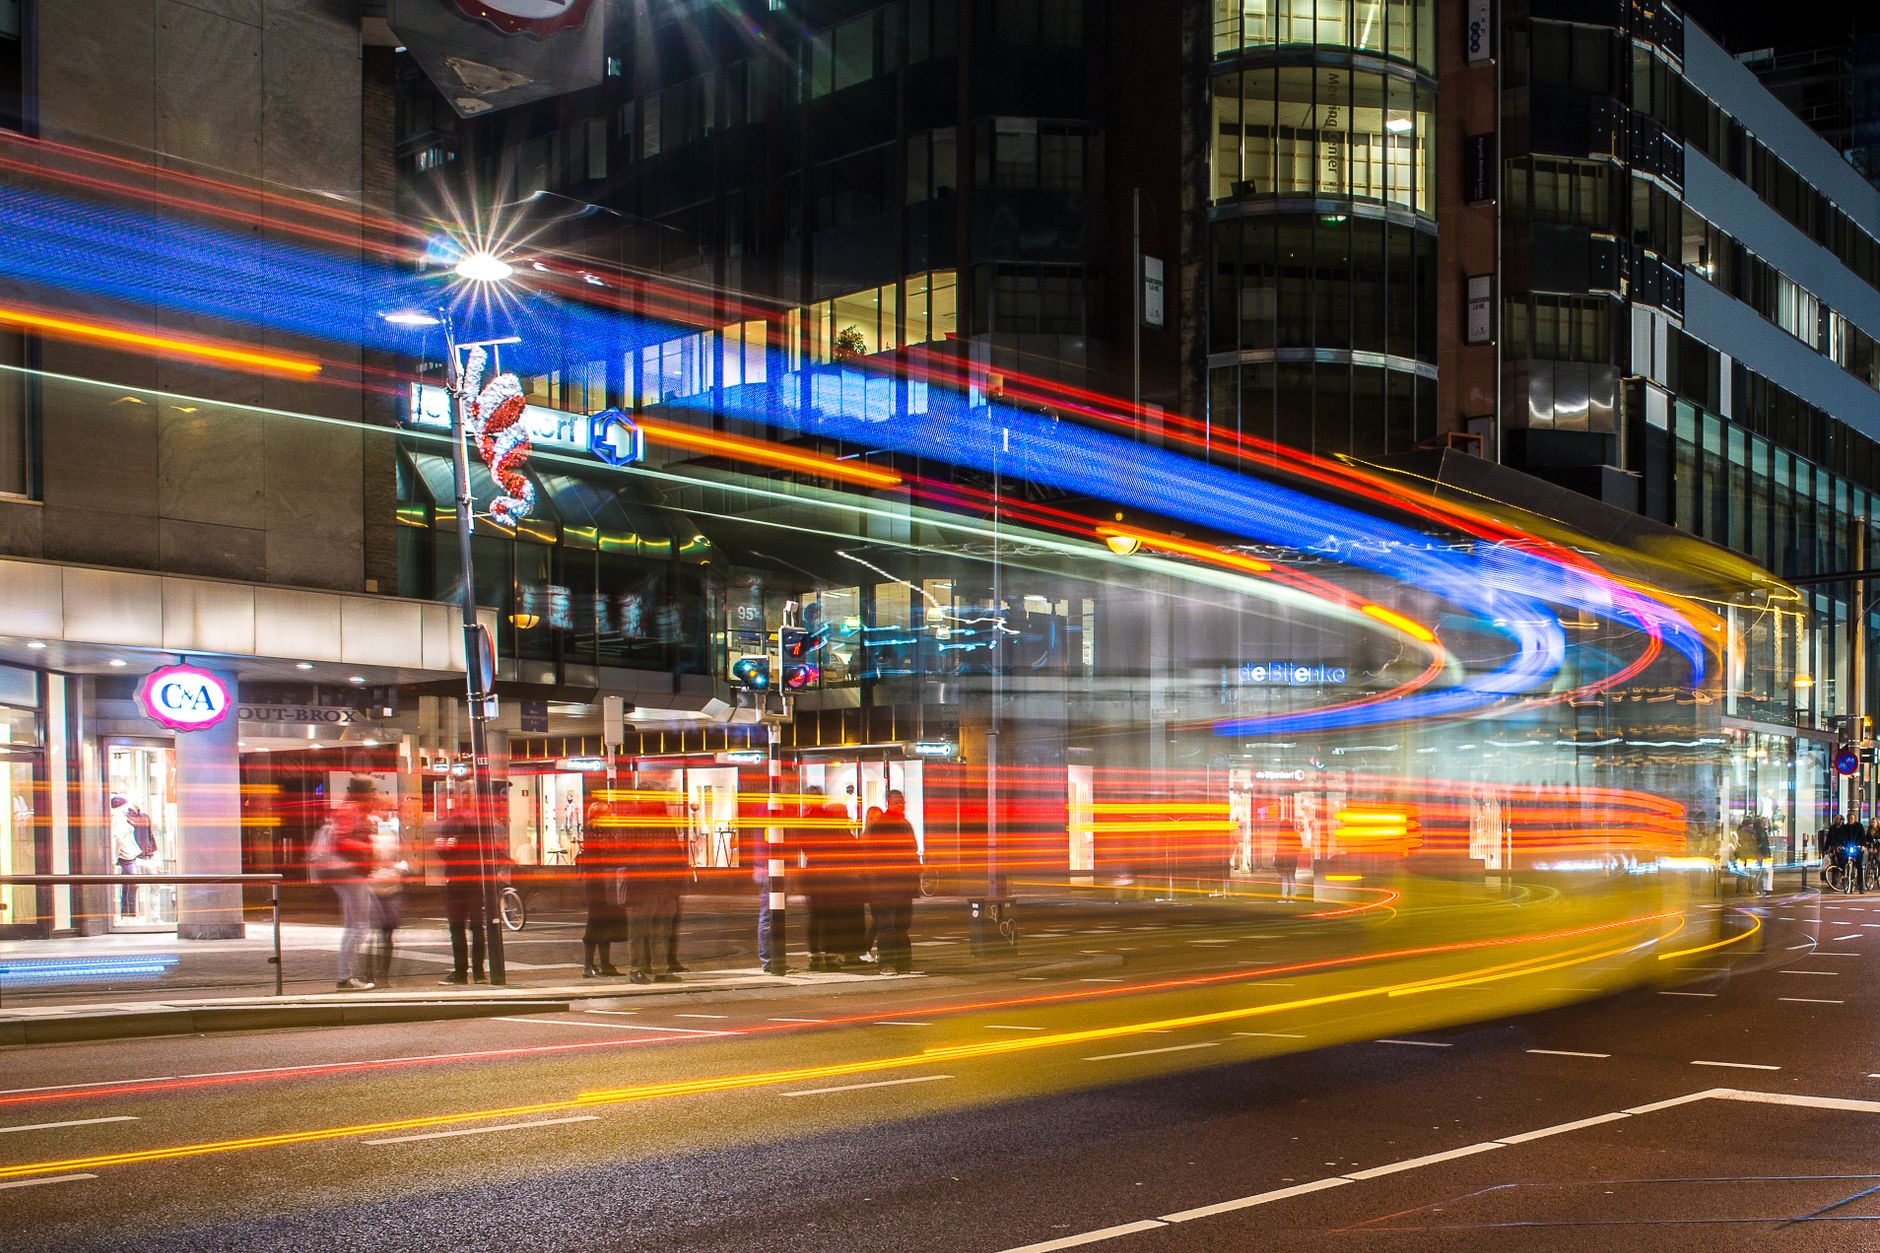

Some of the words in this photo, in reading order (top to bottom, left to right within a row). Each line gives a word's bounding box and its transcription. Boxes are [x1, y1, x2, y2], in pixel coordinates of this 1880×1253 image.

[1328, 132, 1339, 173] Center
[160, 682, 216, 710] C&A
[238, 707, 359, 722] OUT-BROX
